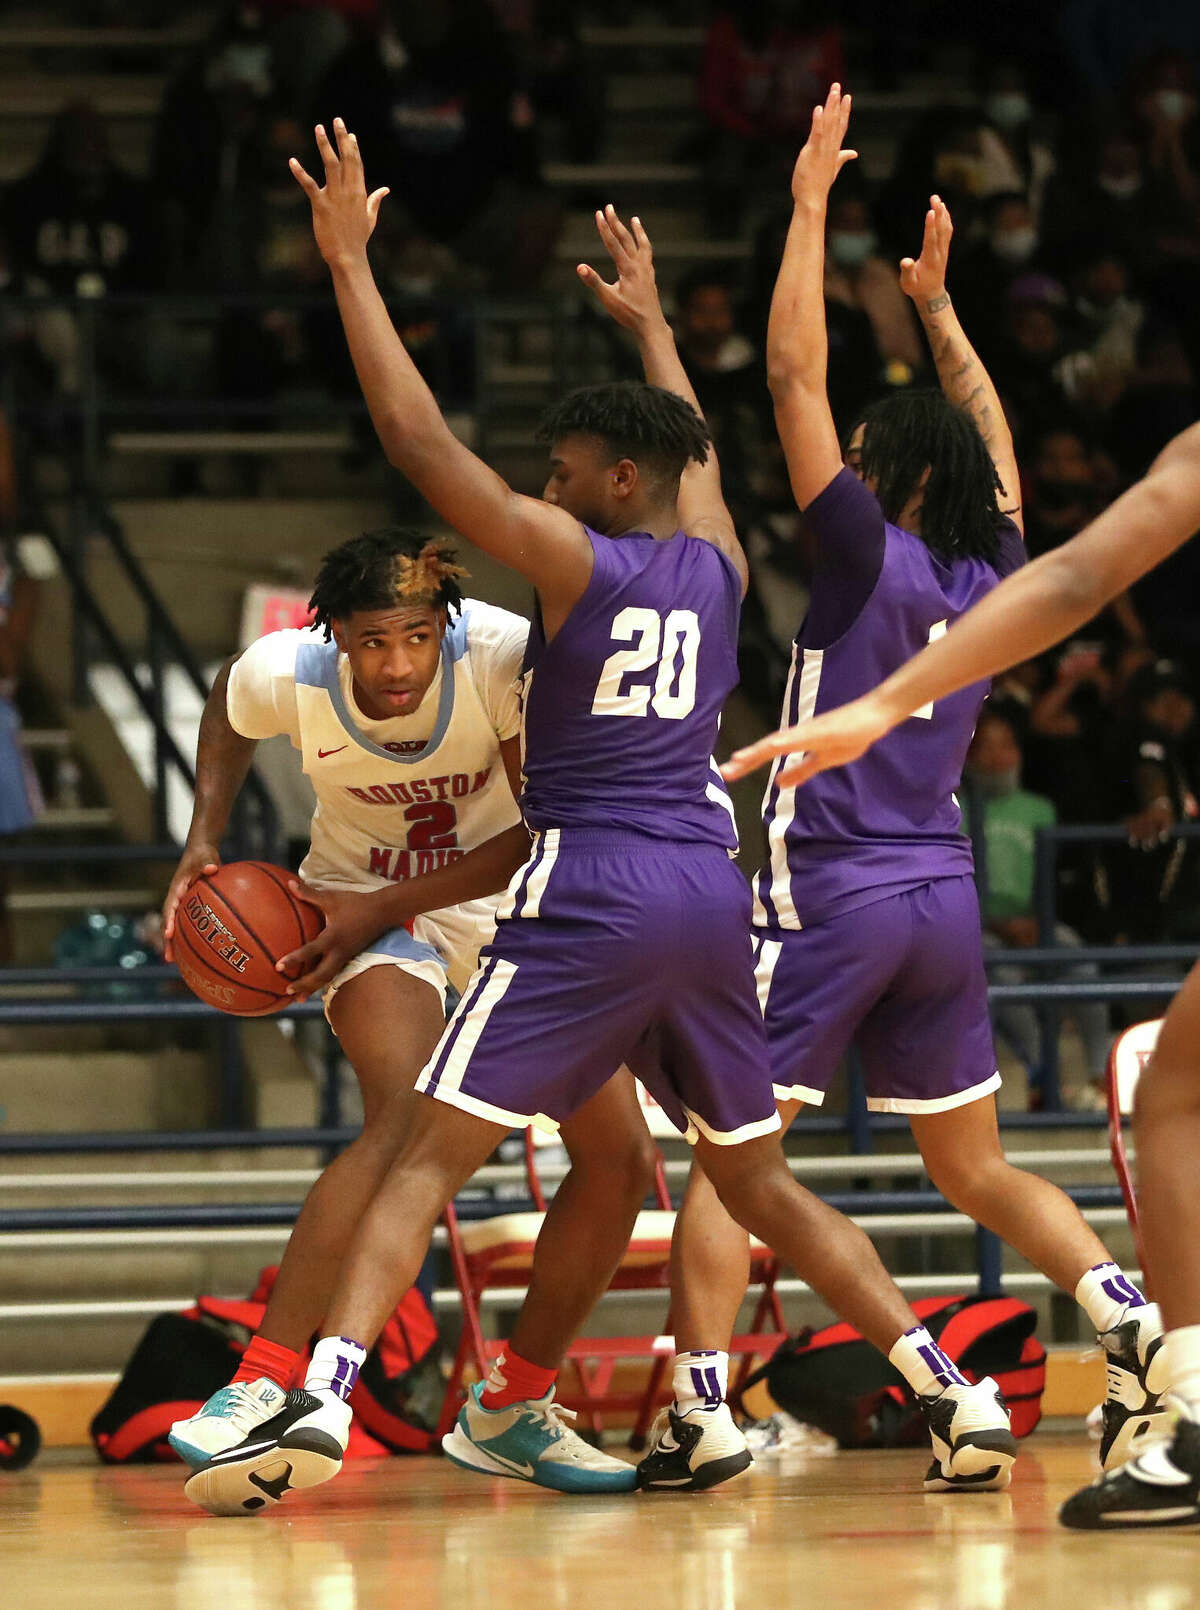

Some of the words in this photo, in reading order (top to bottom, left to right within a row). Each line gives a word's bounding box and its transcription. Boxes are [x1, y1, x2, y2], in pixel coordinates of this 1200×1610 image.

[591, 606, 701, 720] 20
[345, 766, 493, 805] HOUSTON
[403, 800, 458, 851] 2
